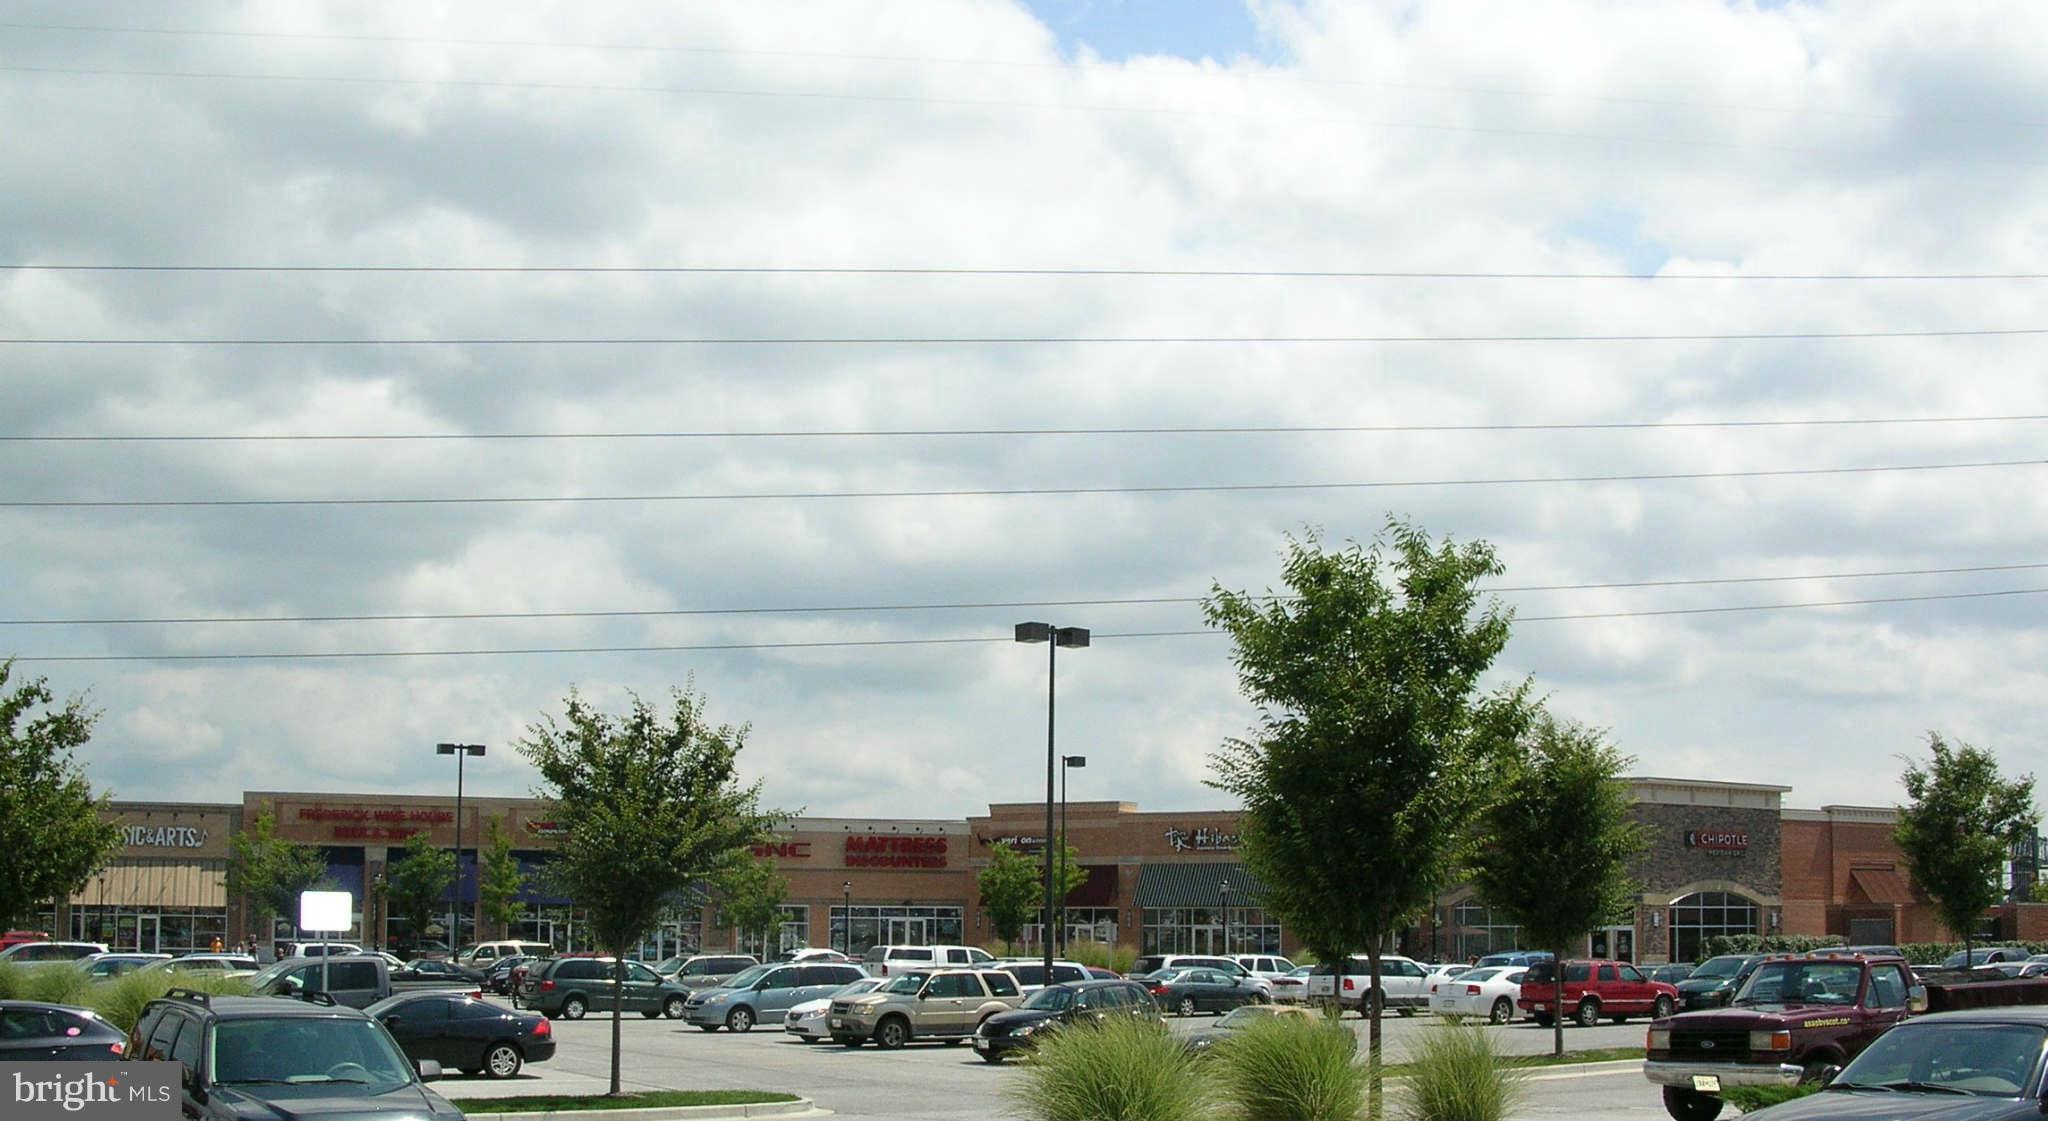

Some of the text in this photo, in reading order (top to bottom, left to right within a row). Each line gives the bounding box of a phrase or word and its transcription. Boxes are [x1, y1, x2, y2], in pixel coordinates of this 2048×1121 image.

[121, 825, 198, 848] SIC&ARTS
[1700, 832, 1749, 846] CHIPOTLE
[846, 836, 948, 854] MATTRESS
[846, 855, 948, 868] DISCOUNTERS
